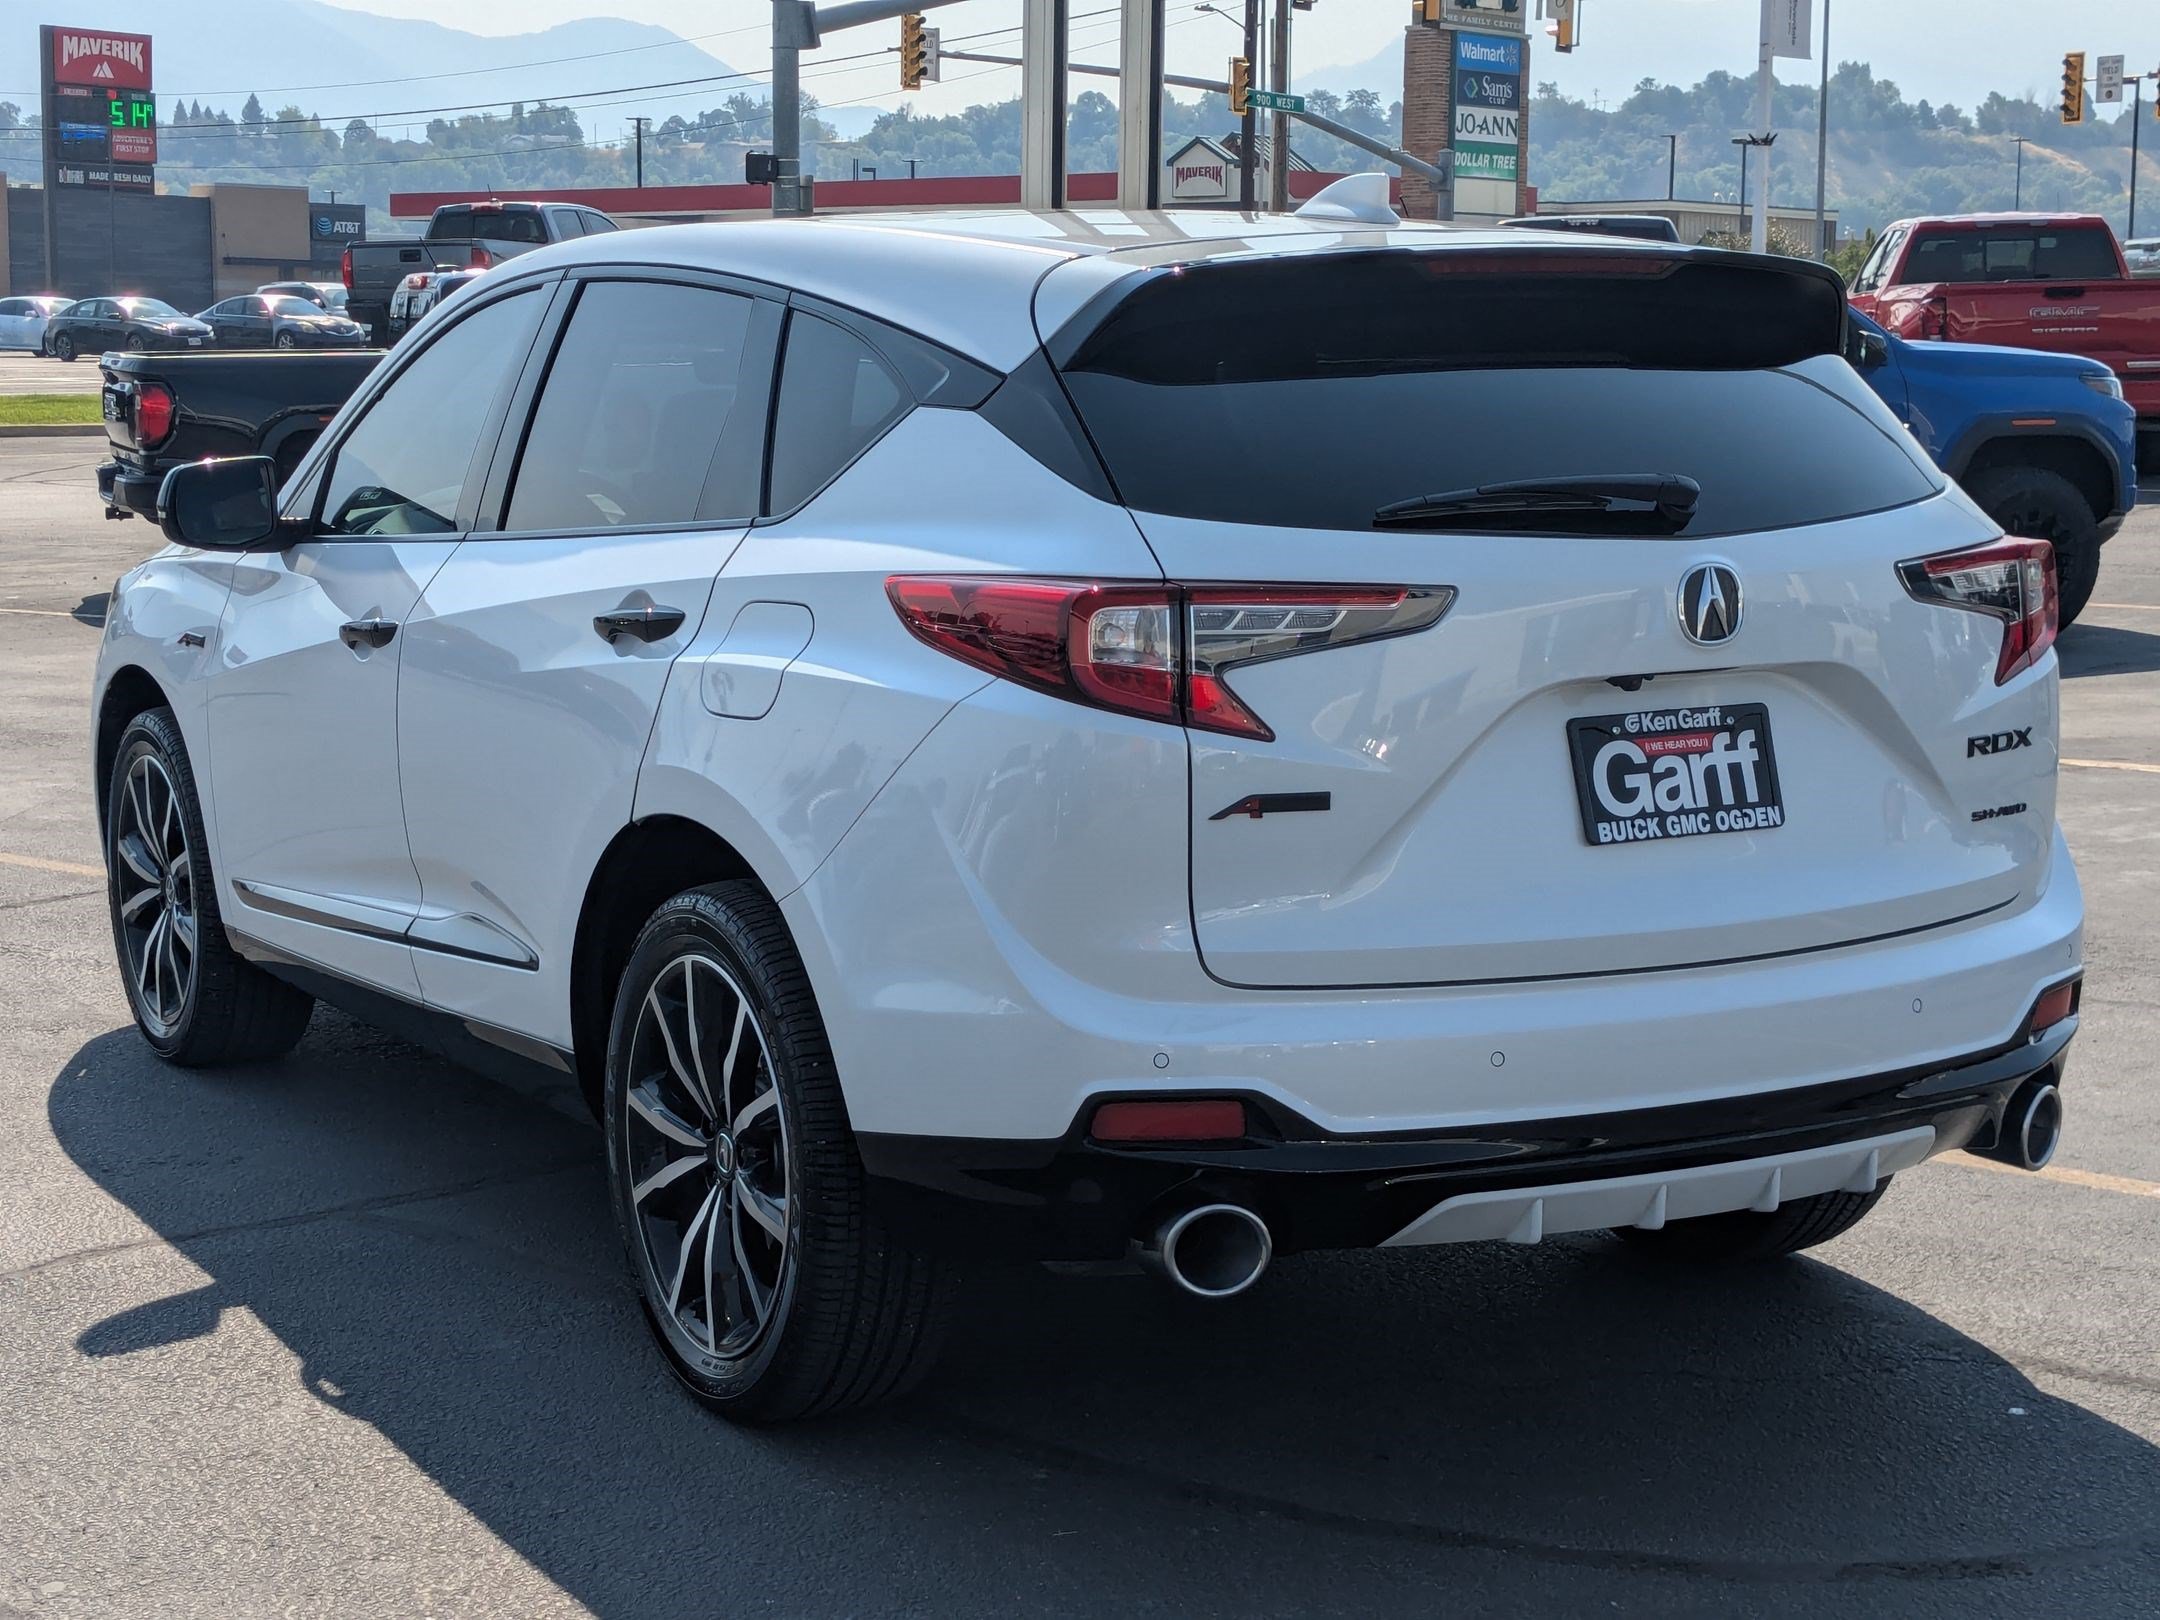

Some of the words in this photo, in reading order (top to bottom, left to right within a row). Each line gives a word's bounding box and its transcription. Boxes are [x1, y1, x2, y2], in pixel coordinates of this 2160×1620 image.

[1462, 15, 1491, 26] FAMILY
[62, 35, 144, 73] MAVERIK
[1460, 42, 1506, 63] Walmart
[1482, 75, 1513, 99] Sam's
[1256, 94, 1271, 106] 900
[1276, 97, 1295, 109] WEST
[1489, 97, 1506, 105] CLUB
[1455, 151, 1489, 169] DOLLAR
[1492, 155, 1516, 169] TREE
[89, 171, 109, 181] MADE
[132, 174, 152, 183] DAILY
[1176, 165, 1223, 190] MAVERIK
[333, 221, 361, 234] AT&T
[1642, 711, 1677, 733] Ken
[1679, 706, 1722, 729] Garff
[1664, 739, 1686, 750] HEAR
[1967, 726, 2033, 758] RDX
[1592, 729, 1760, 818] Garff
[1597, 817, 1663, 844] BUICK
[1666, 814, 1712, 836] GMC
[1715, 805, 1782, 830] OGDEN
